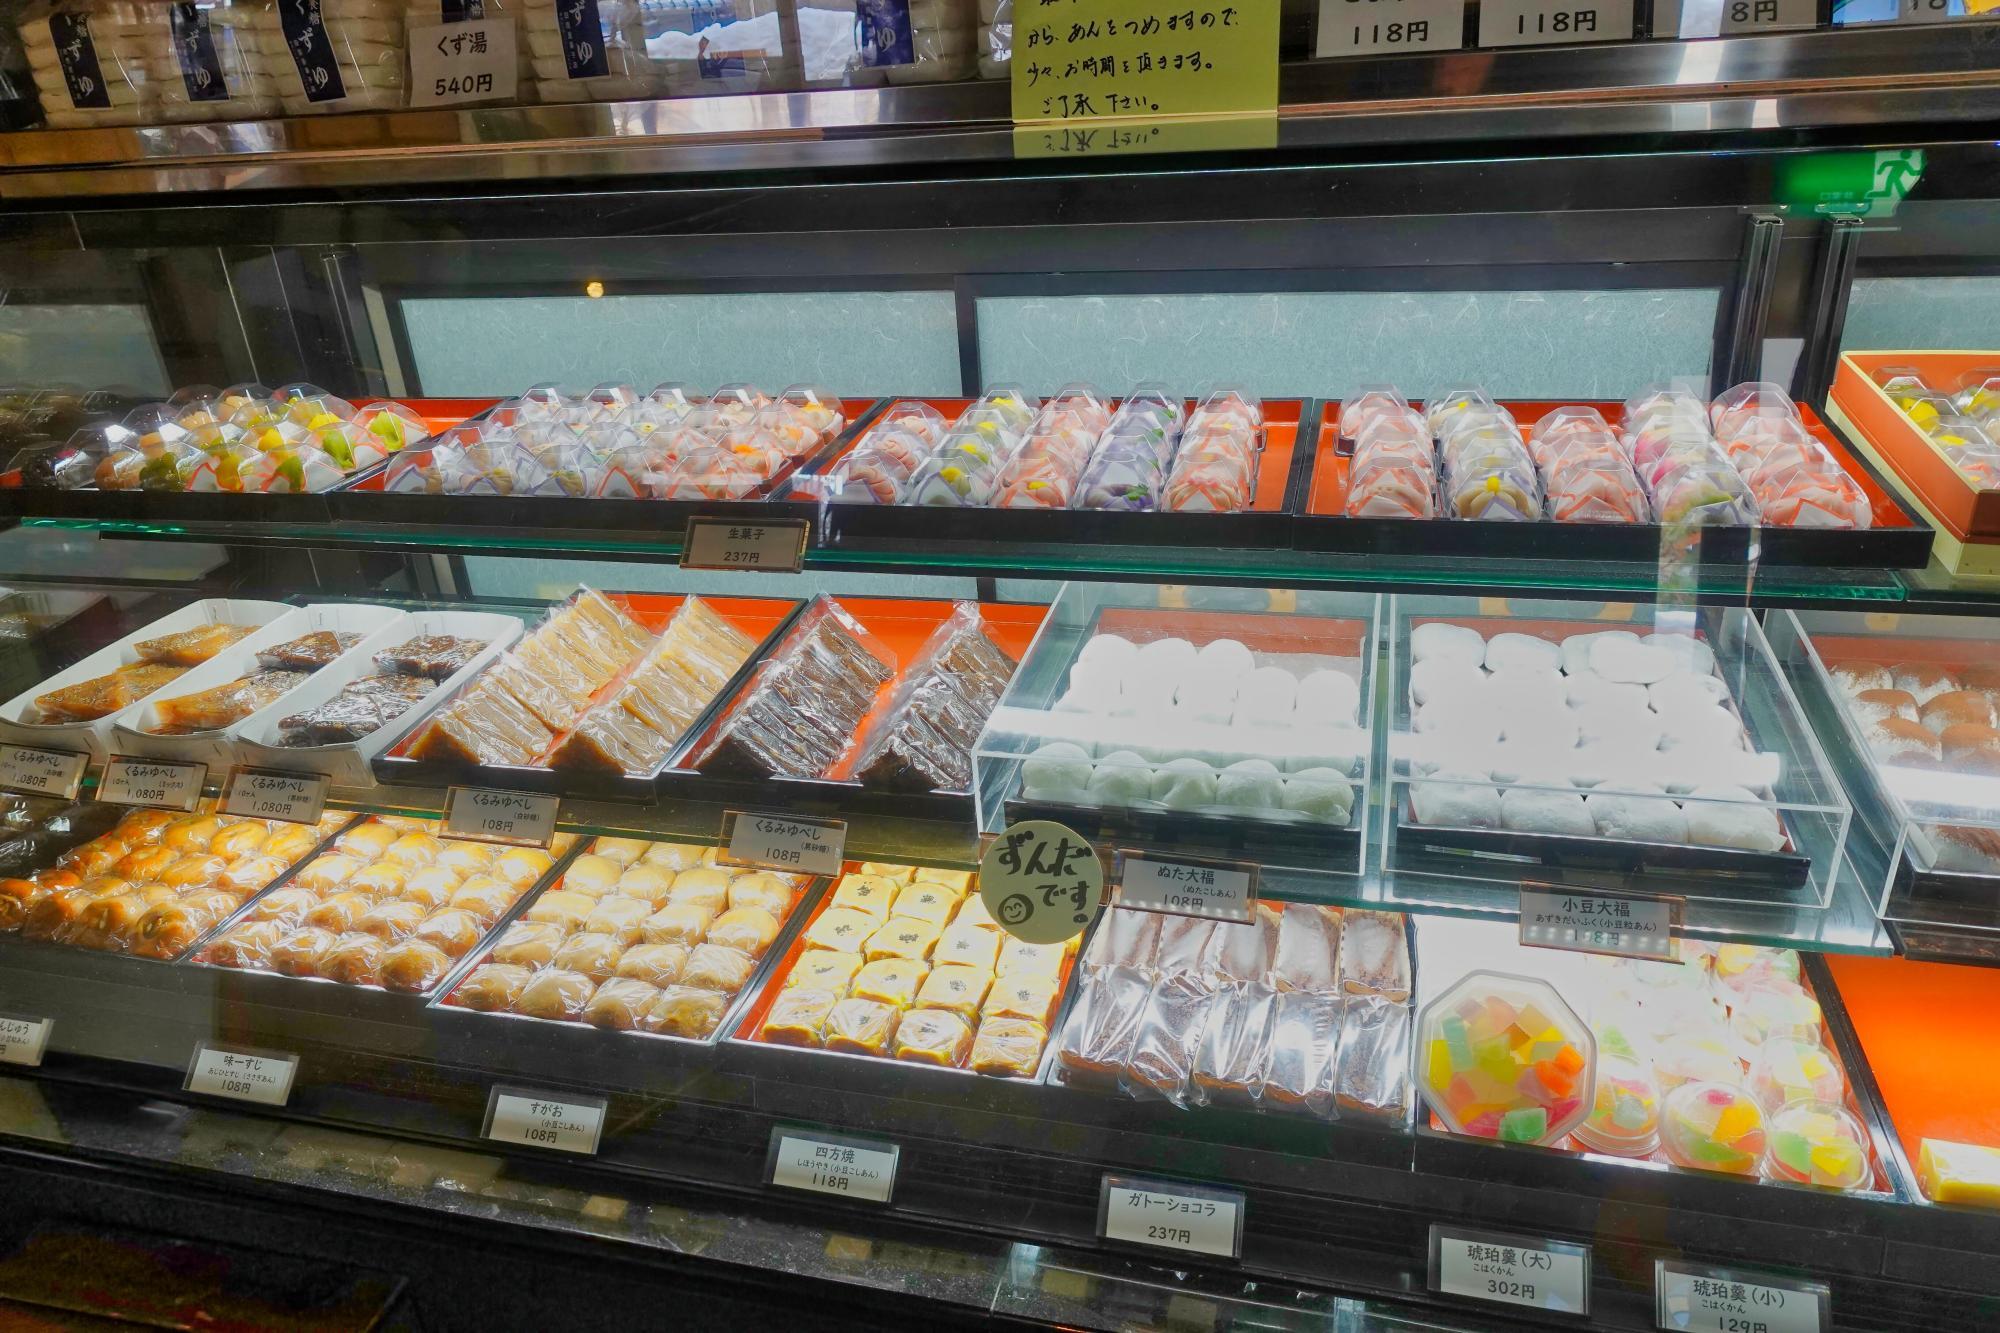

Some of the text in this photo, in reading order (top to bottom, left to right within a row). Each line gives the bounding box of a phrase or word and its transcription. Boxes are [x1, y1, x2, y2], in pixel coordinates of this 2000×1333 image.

[1519, 9, 1597, 33] 118円
[1354, 20, 1428, 45] 118円
[437, 31, 488, 57] くず湯
[435, 74, 493, 97] 540円
[728, 527, 765, 540] 生菓子
[724, 551, 760, 563] 237円
[125, 766, 177, 778] くるみゆべし
[251, 777, 304, 793] くるみゆべし
[127, 789, 166, 800] 1,080円
[472, 793, 532, 810] くるみゆべし
[252, 801, 293, 815] 1,080円
[482, 819, 514, 833] 108円
[755, 819, 821, 840] くるみゆべし
[765, 847, 801, 864] 108円
[994, 830, 1093, 877] ずんだ
[1157, 865, 1215, 886] ぬた大福
[1561, 897, 1631, 918] 小豆大福
[1574, 929, 1620, 946] 18円
[224, 1055, 262, 1071] 味一すじ
[221, 1080, 251, 1094] 108円
[530, 1102, 563, 1117] すがお
[525, 1127, 558, 1143] 108円
[816, 1145, 855, 1164] 四方焼
[812, 1173, 849, 1190] 118円
[1128, 1192, 1216, 1217] ガトーショコラ
[1148, 1225, 1191, 1244] 237円
[1473, 1263, 1514, 1276] こはくかん
[1487, 1279, 1535, 1299] 302円
[1702, 1299, 1746, 1314] こはくかん
